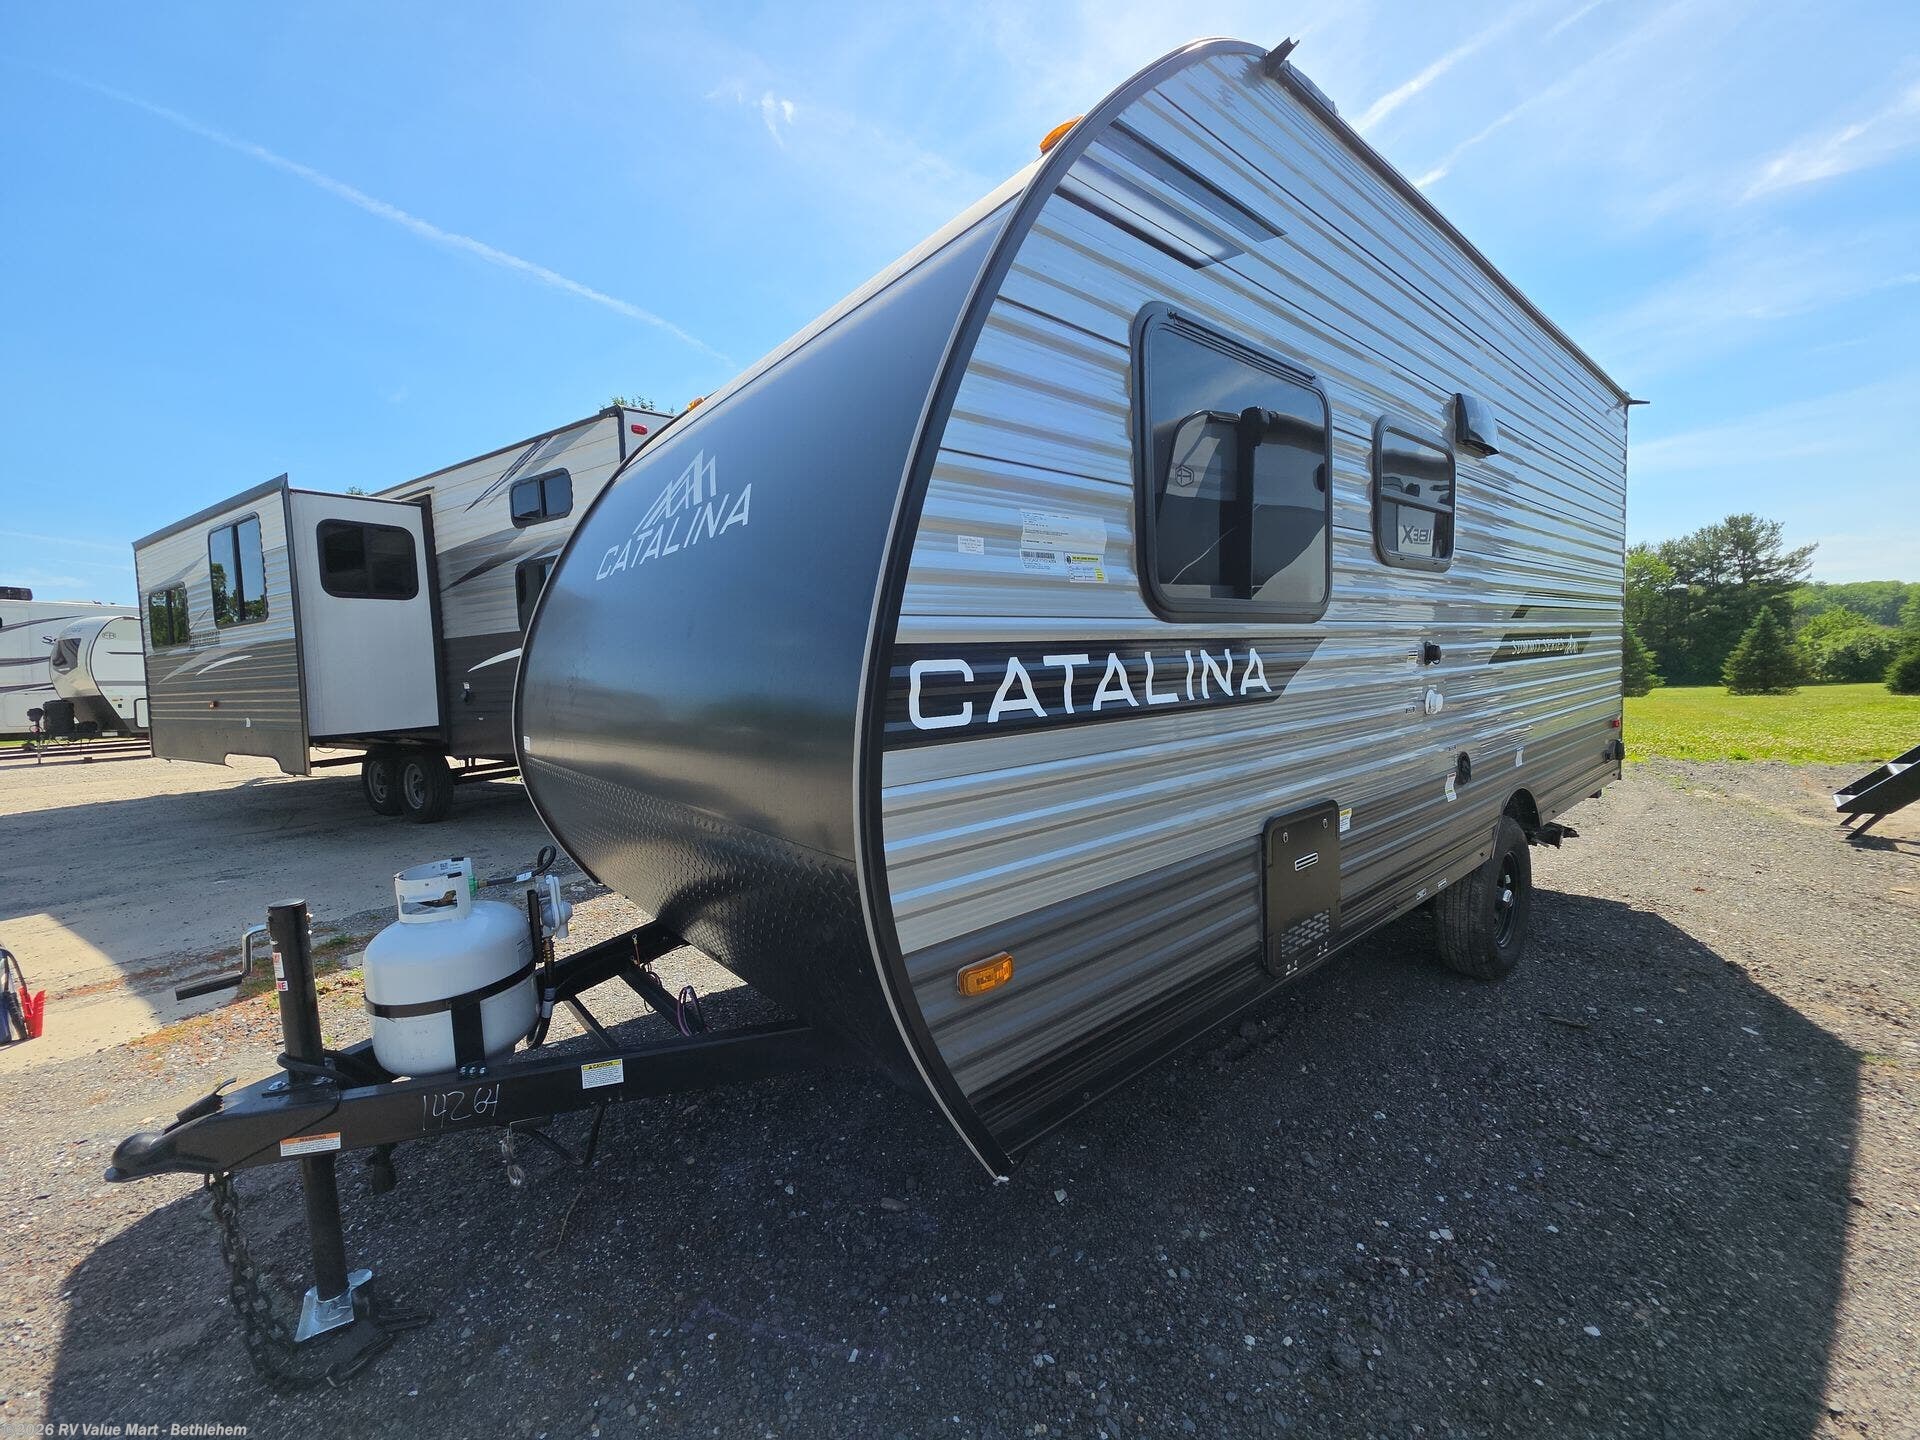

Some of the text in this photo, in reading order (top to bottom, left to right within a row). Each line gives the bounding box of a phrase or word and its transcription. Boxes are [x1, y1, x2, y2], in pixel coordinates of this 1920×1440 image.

[596, 483, 752, 580] CATALINA
[908, 647, 1272, 730] CATALINA
[421, 1083, 500, 1131] 14264
